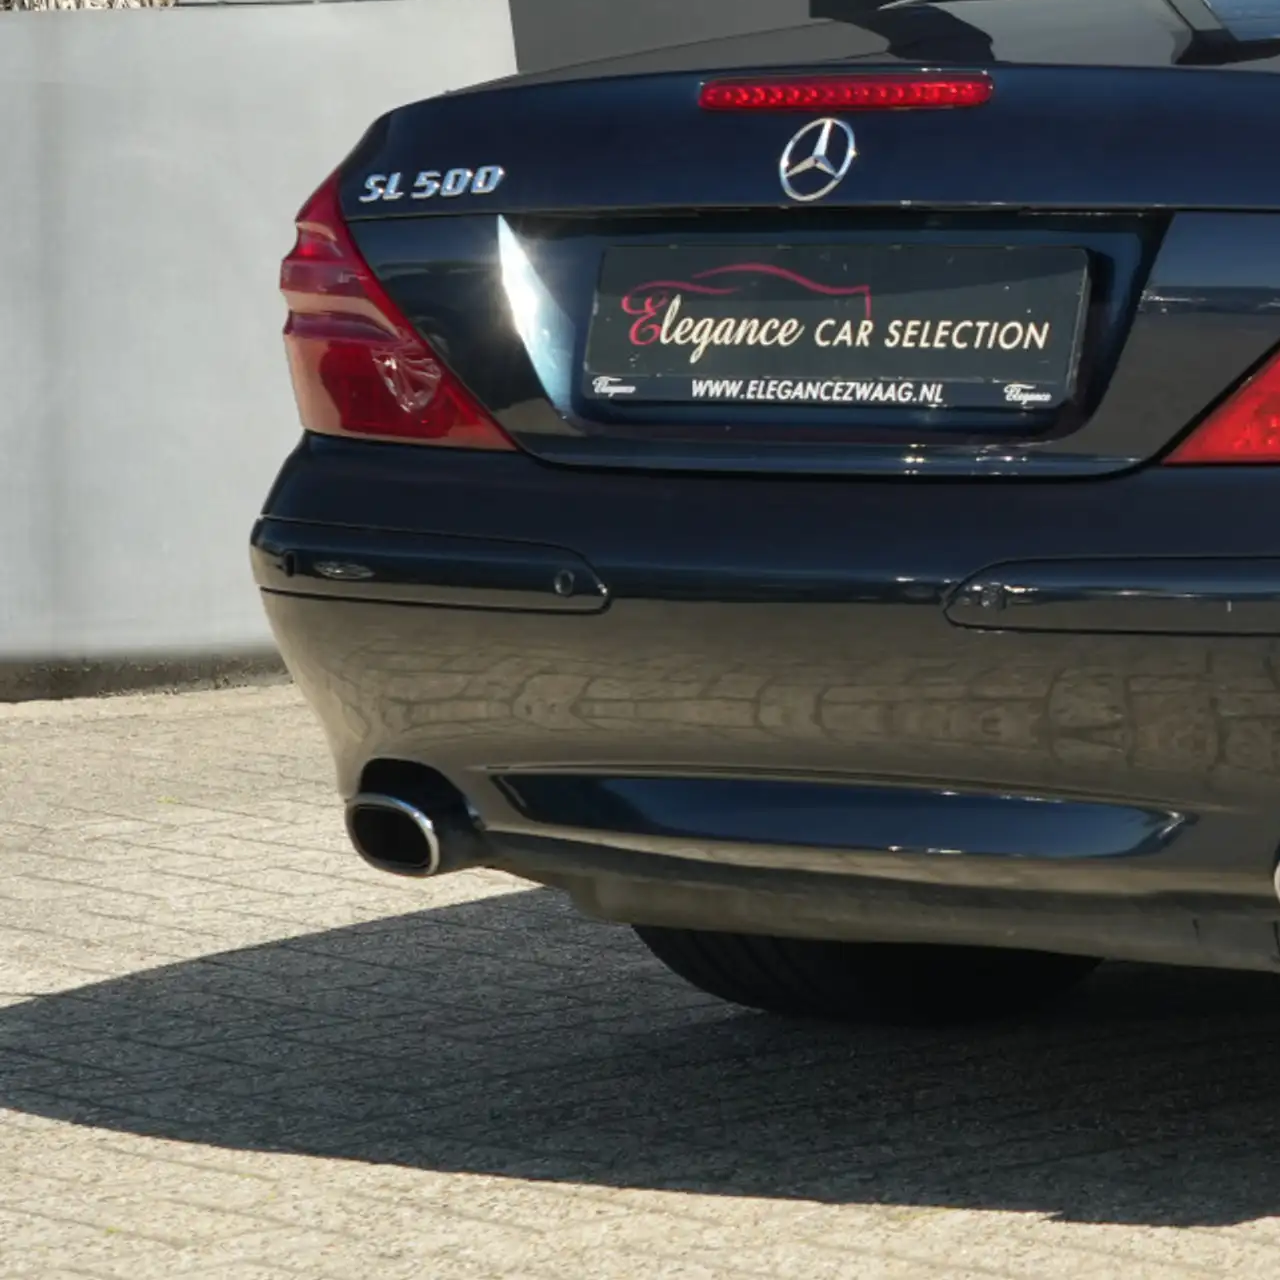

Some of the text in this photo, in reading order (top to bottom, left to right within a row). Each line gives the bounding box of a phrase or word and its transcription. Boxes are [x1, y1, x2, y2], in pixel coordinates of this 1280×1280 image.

[358, 165, 506, 204] SL 500
[621, 292, 1051, 364] Elegance CAR SELECTION
[690, 378, 945, 404] WWW.ELEGANCEZWAAG.NL
